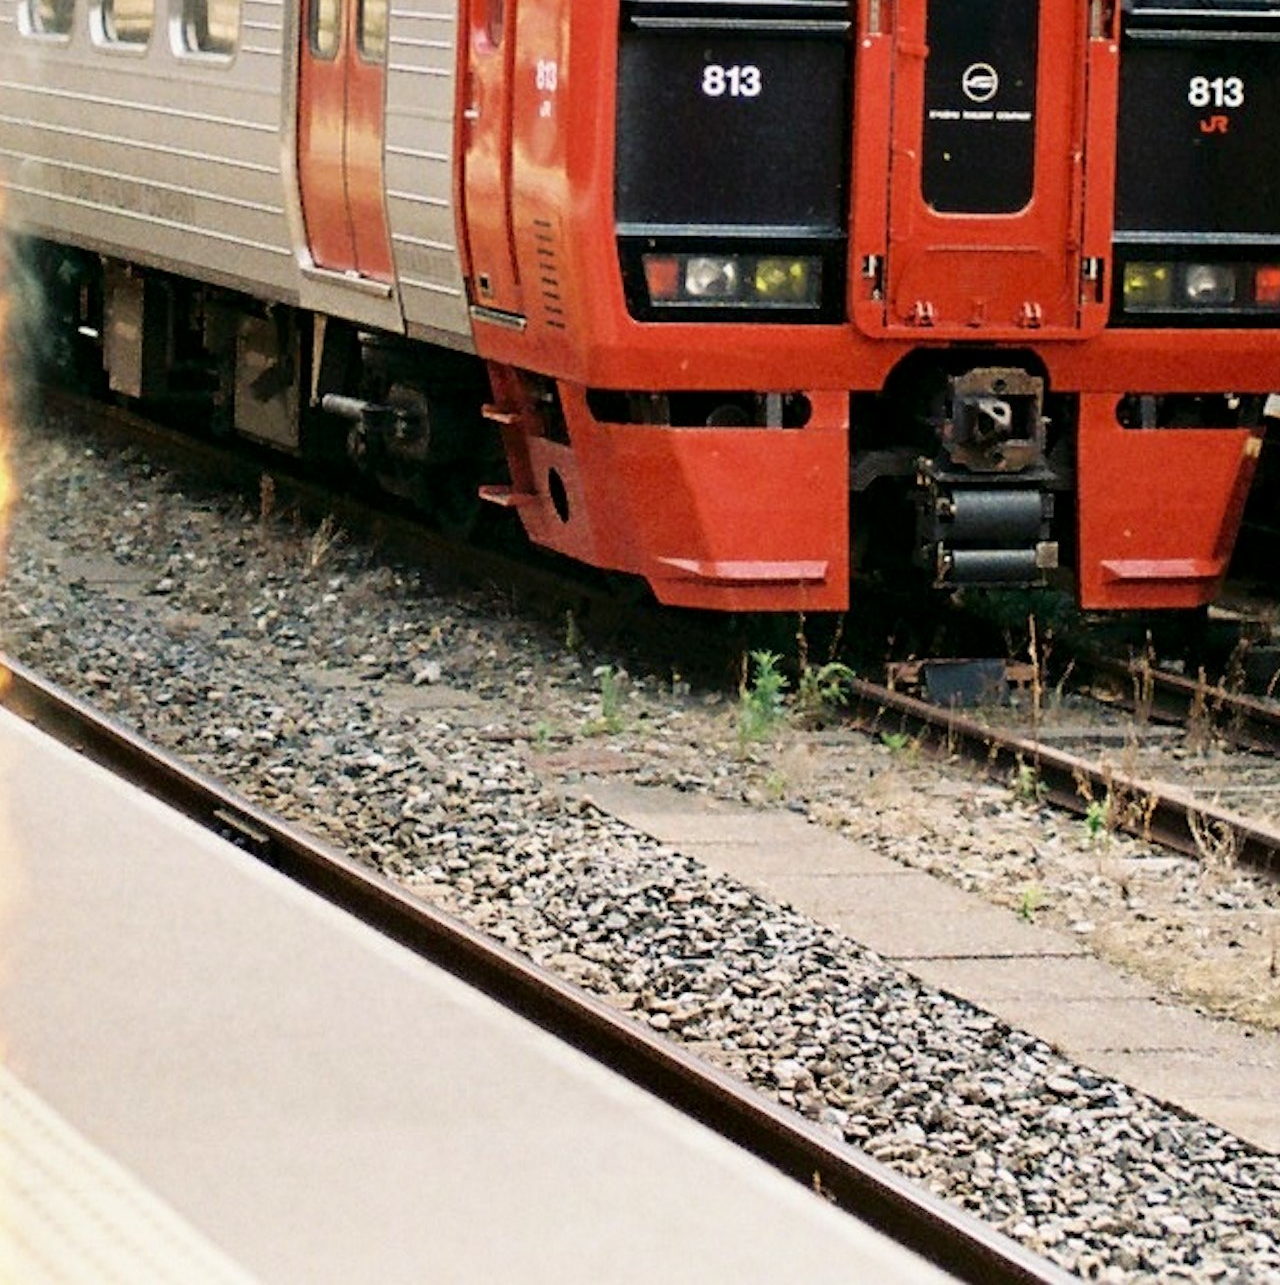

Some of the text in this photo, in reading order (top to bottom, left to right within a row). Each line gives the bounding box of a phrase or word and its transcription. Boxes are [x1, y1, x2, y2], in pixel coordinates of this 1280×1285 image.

[701, 64, 763, 97] 813
[1187, 75, 1245, 108] 813
[1199, 114, 1229, 135] JR
